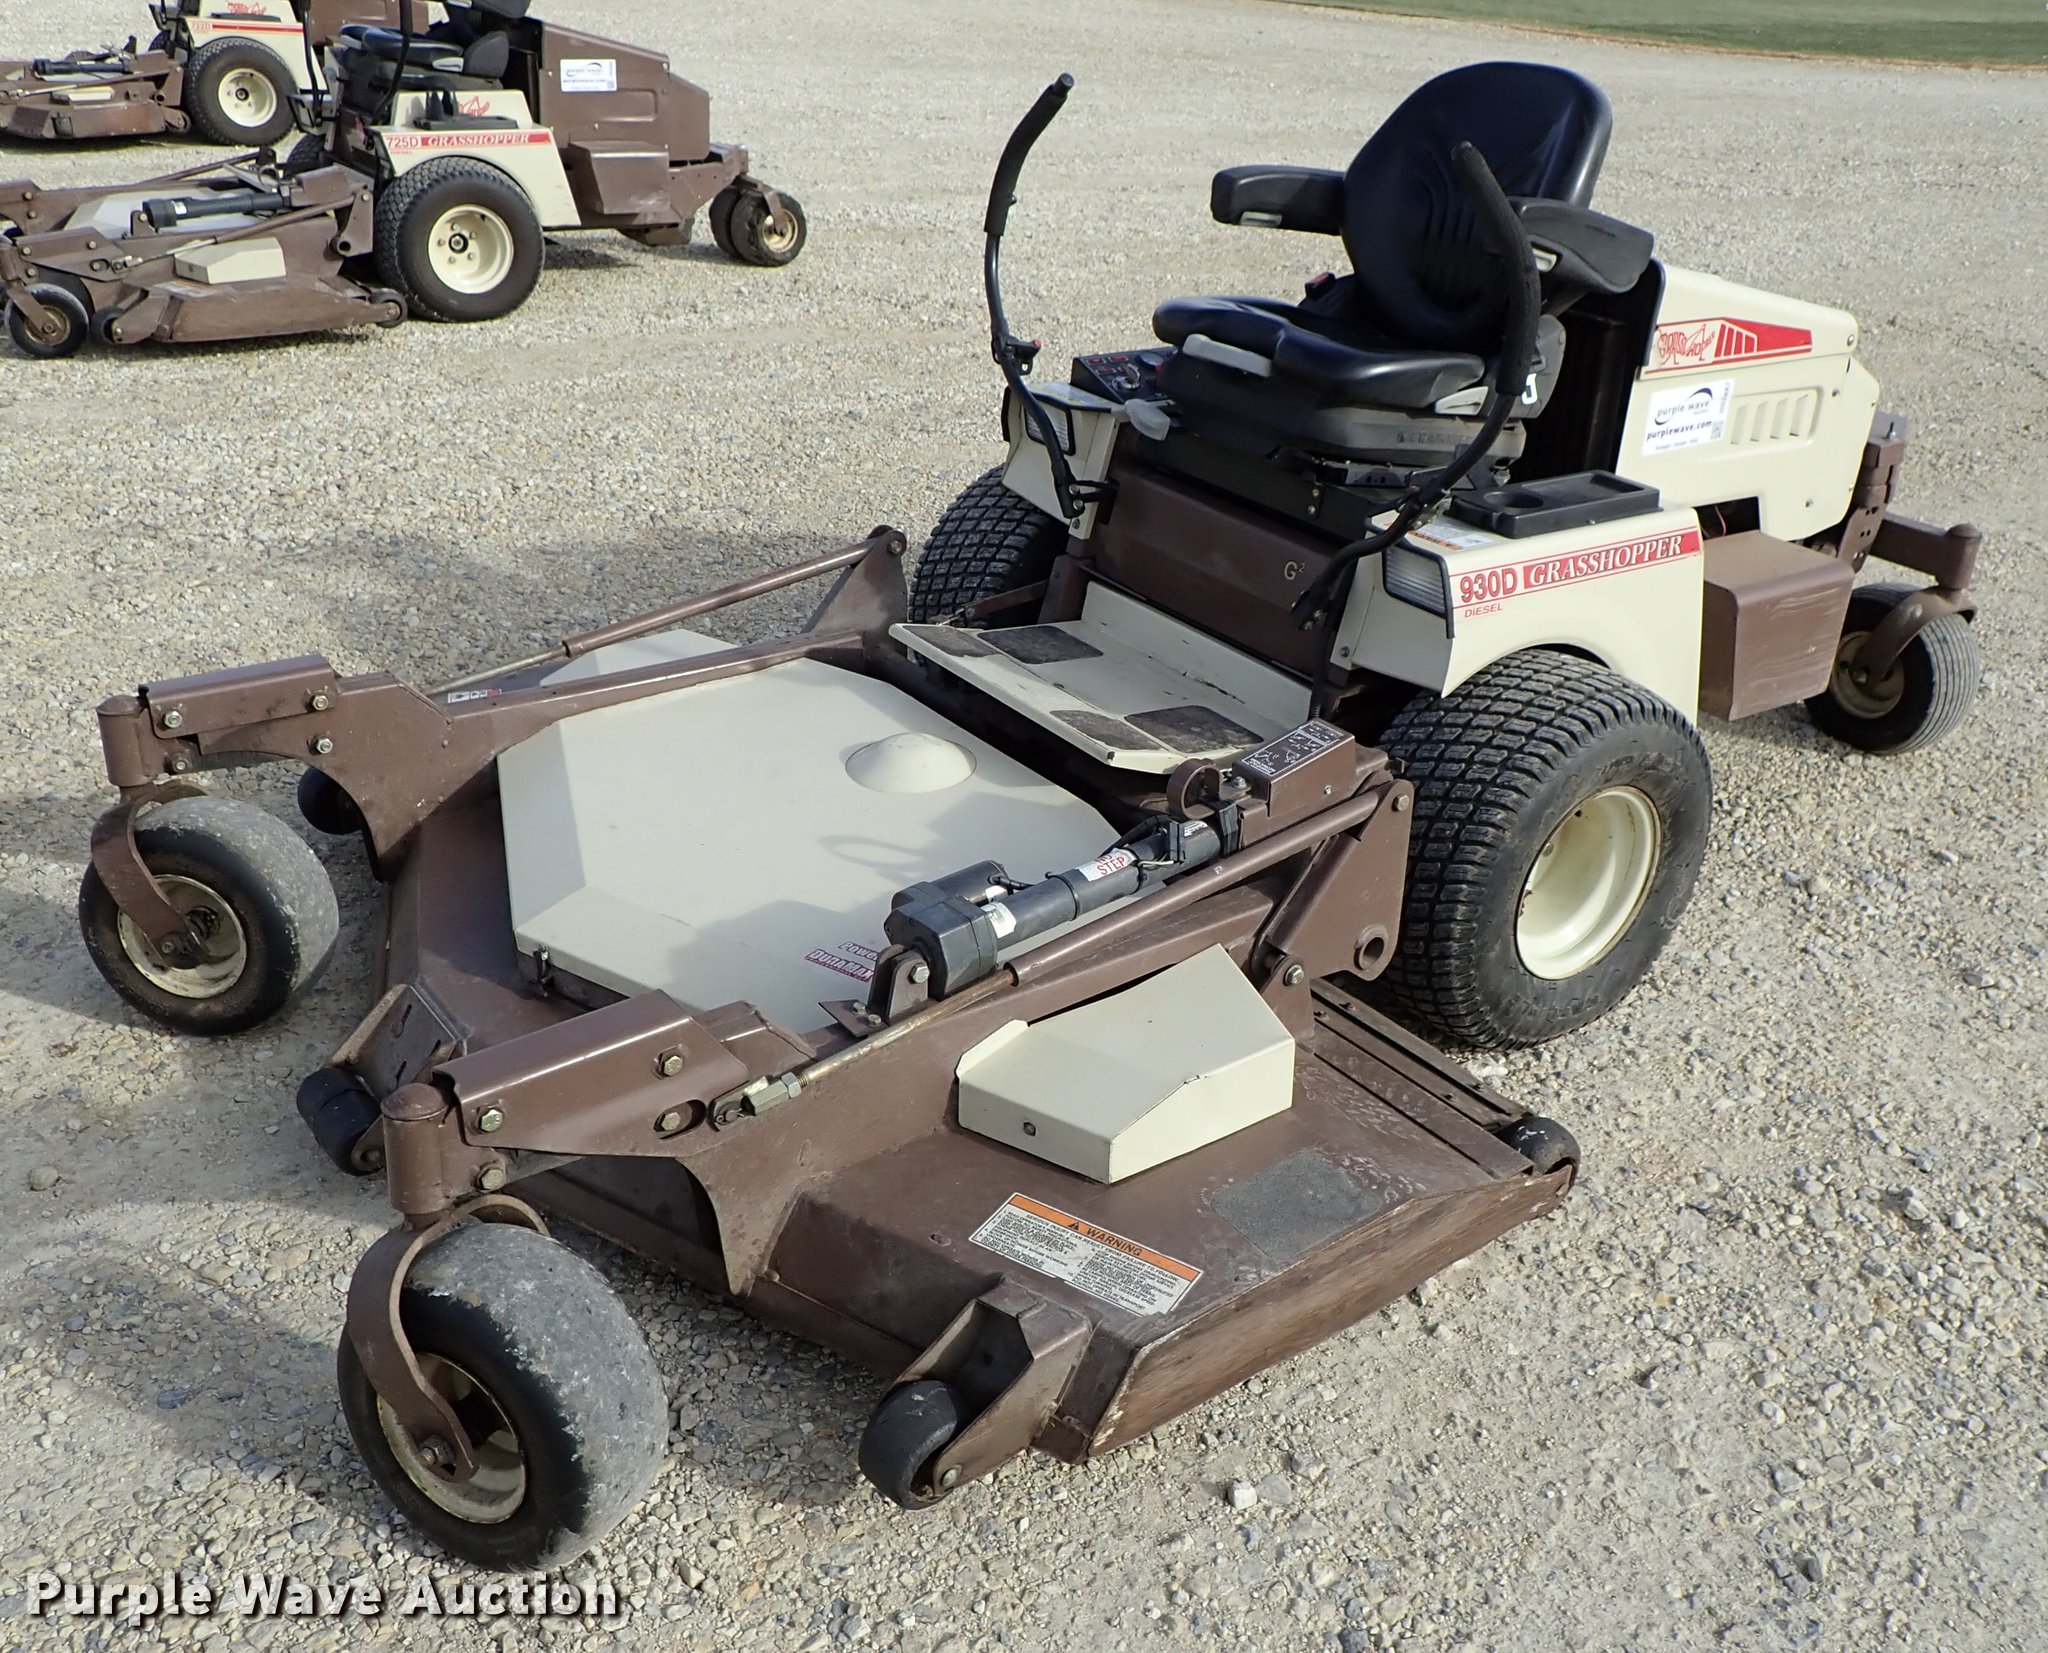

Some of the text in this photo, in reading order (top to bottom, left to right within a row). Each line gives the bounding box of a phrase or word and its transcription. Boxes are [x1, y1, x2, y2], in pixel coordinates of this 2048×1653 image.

[387, 134, 530, 148] 725D GRASSHOPPER
[1657, 404, 1685, 418] purple
[1688, 400, 1710, 411] wave
[1646, 420, 1712, 442] purplewave.com
[1459, 534, 1684, 604] 930D GRASSHOPPER
[1464, 602, 1503, 618] DIESEL
[1096, 856, 1125, 875] STEP
[1084, 1226, 1144, 1257] WARNING
